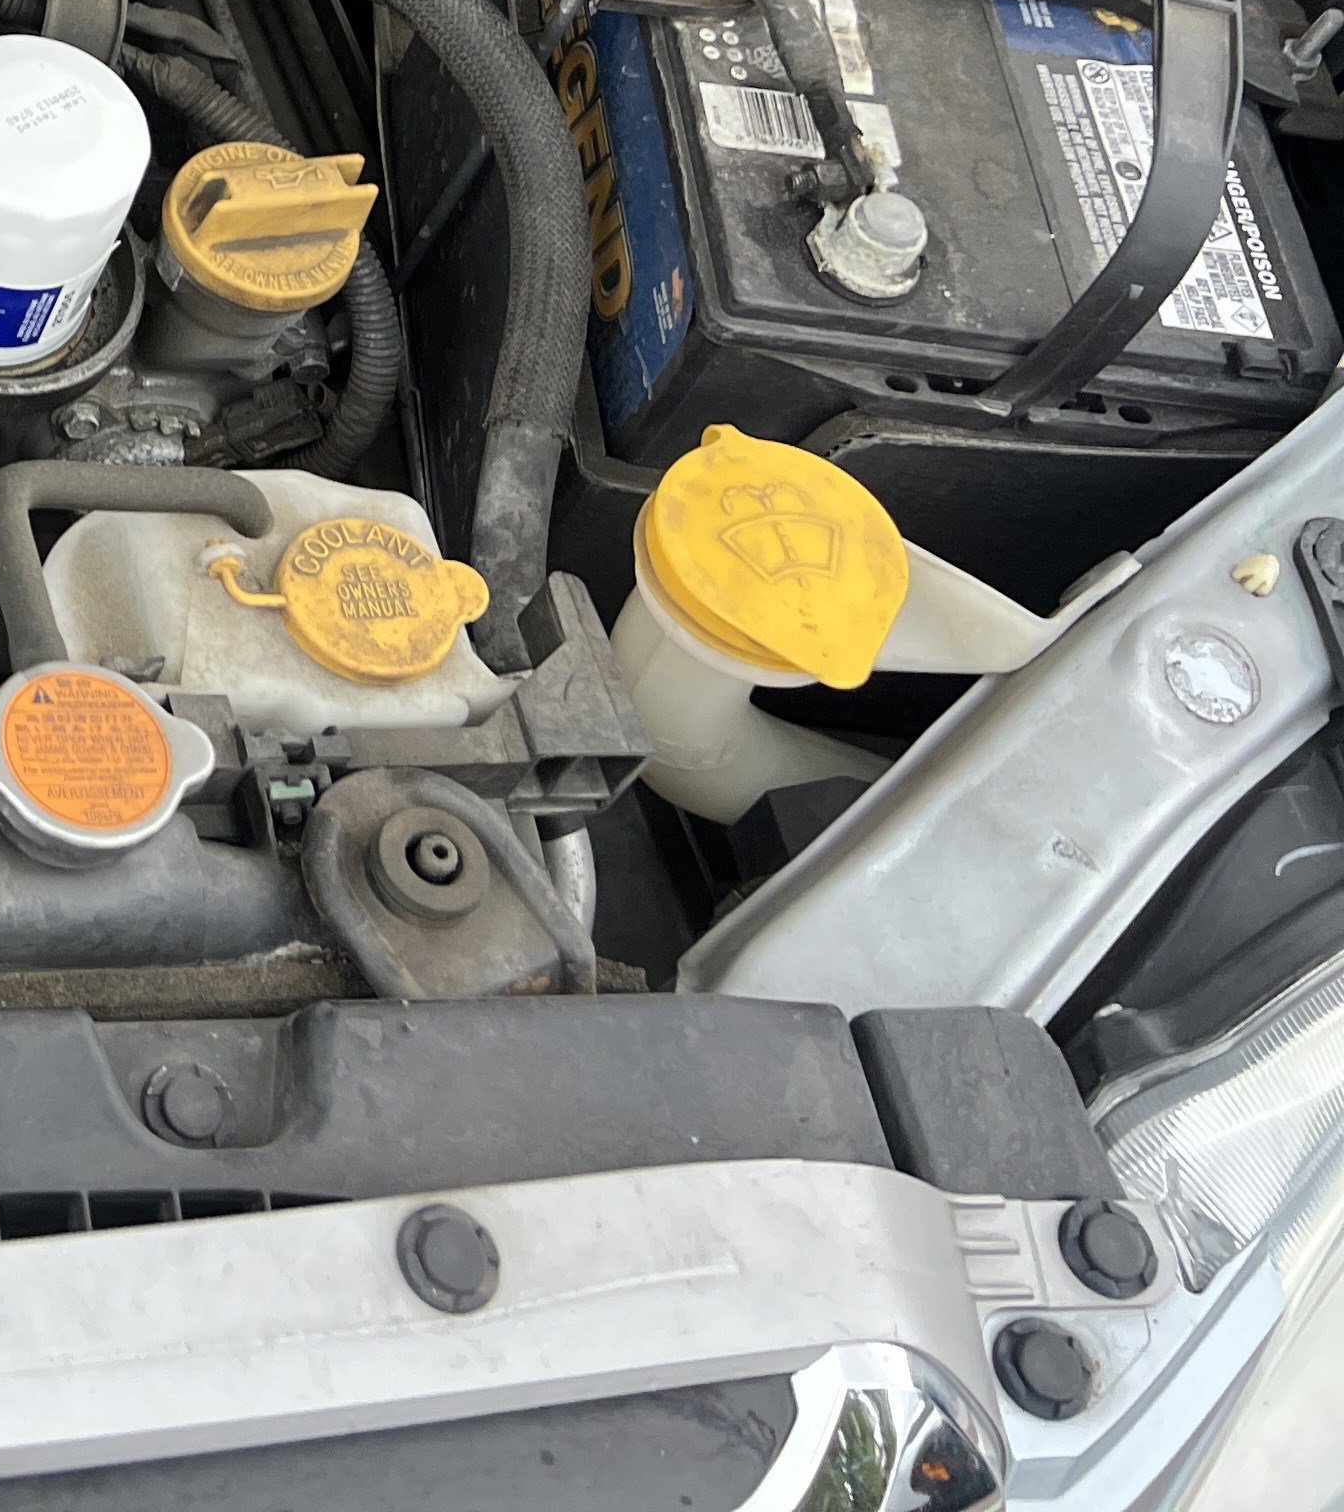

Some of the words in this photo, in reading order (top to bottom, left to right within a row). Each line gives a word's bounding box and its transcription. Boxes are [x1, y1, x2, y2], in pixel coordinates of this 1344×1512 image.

[184, 144, 261, 184] ENGINE
[1224, 162, 1283, 301] NGER/POISON
[213, 252, 239, 277] SEE
[294, 522, 433, 575] COOLANT
[340, 563, 377, 582] SEE
[341, 598, 419, 619] MANUAL
[47, 786, 145, 800] AVERTISSEMENT
